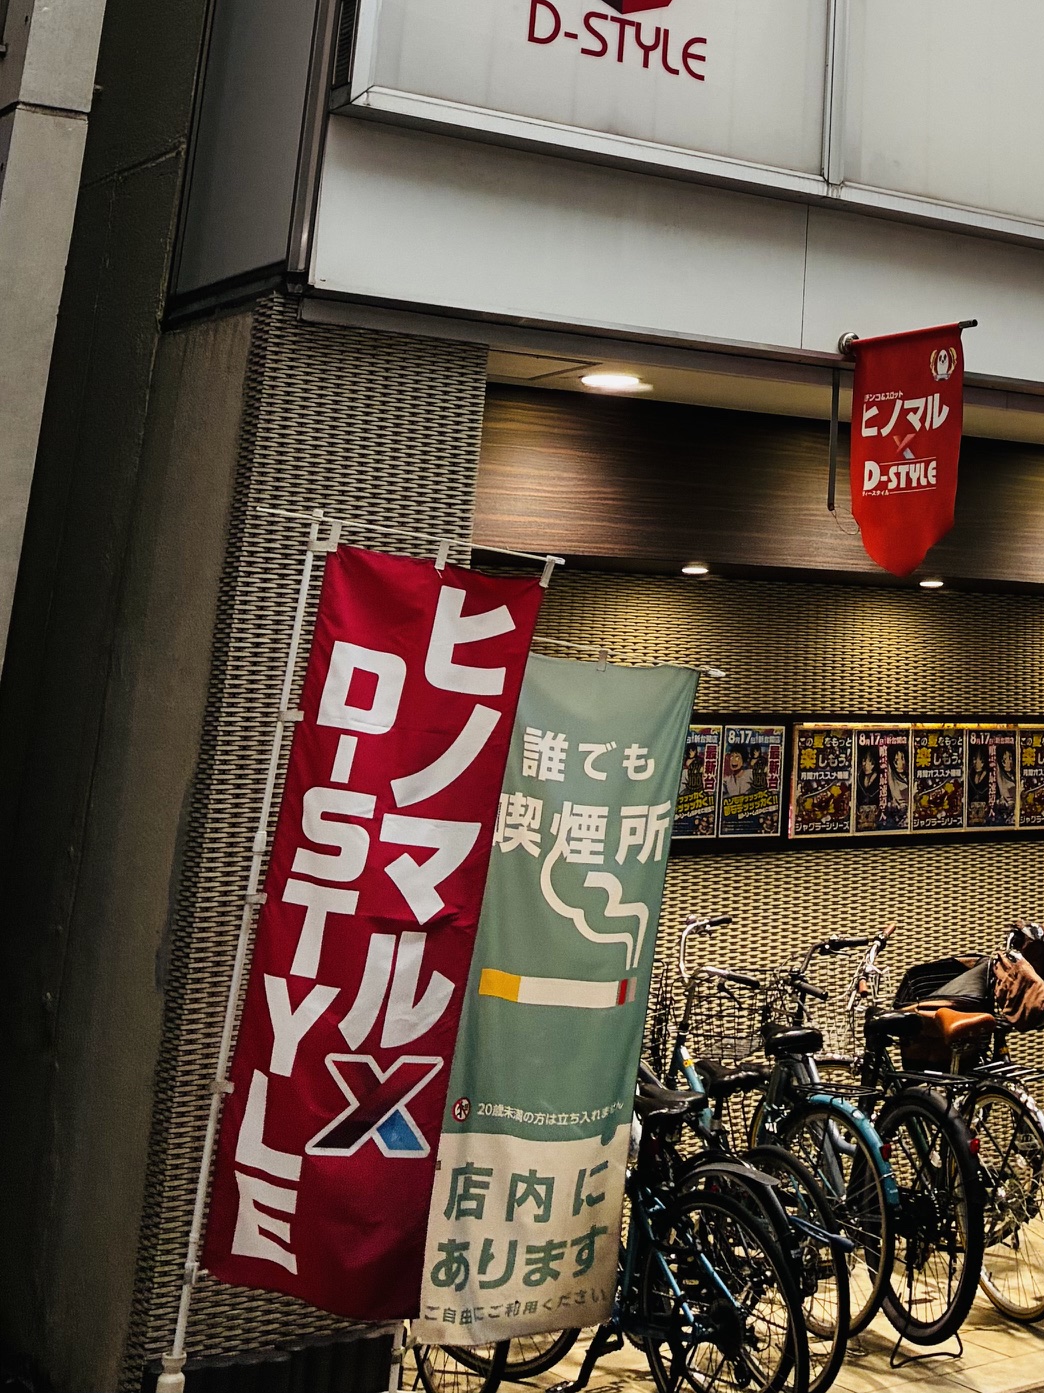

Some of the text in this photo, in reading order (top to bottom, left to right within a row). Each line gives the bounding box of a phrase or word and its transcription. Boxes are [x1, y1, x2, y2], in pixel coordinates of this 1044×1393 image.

[861, 393, 950, 437] ヒノマル
[863, 460, 937, 490] D-STYLE
[522, 726, 655, 782] 誰でも
[338, 585, 516, 1051] ヒノマル
[493, 792, 672, 865] 喫煙所
[231, 641, 407, 1276] D-STYLE
[443, 1160, 609, 1223] 店内に
[430, 1224, 609, 1292] あります
